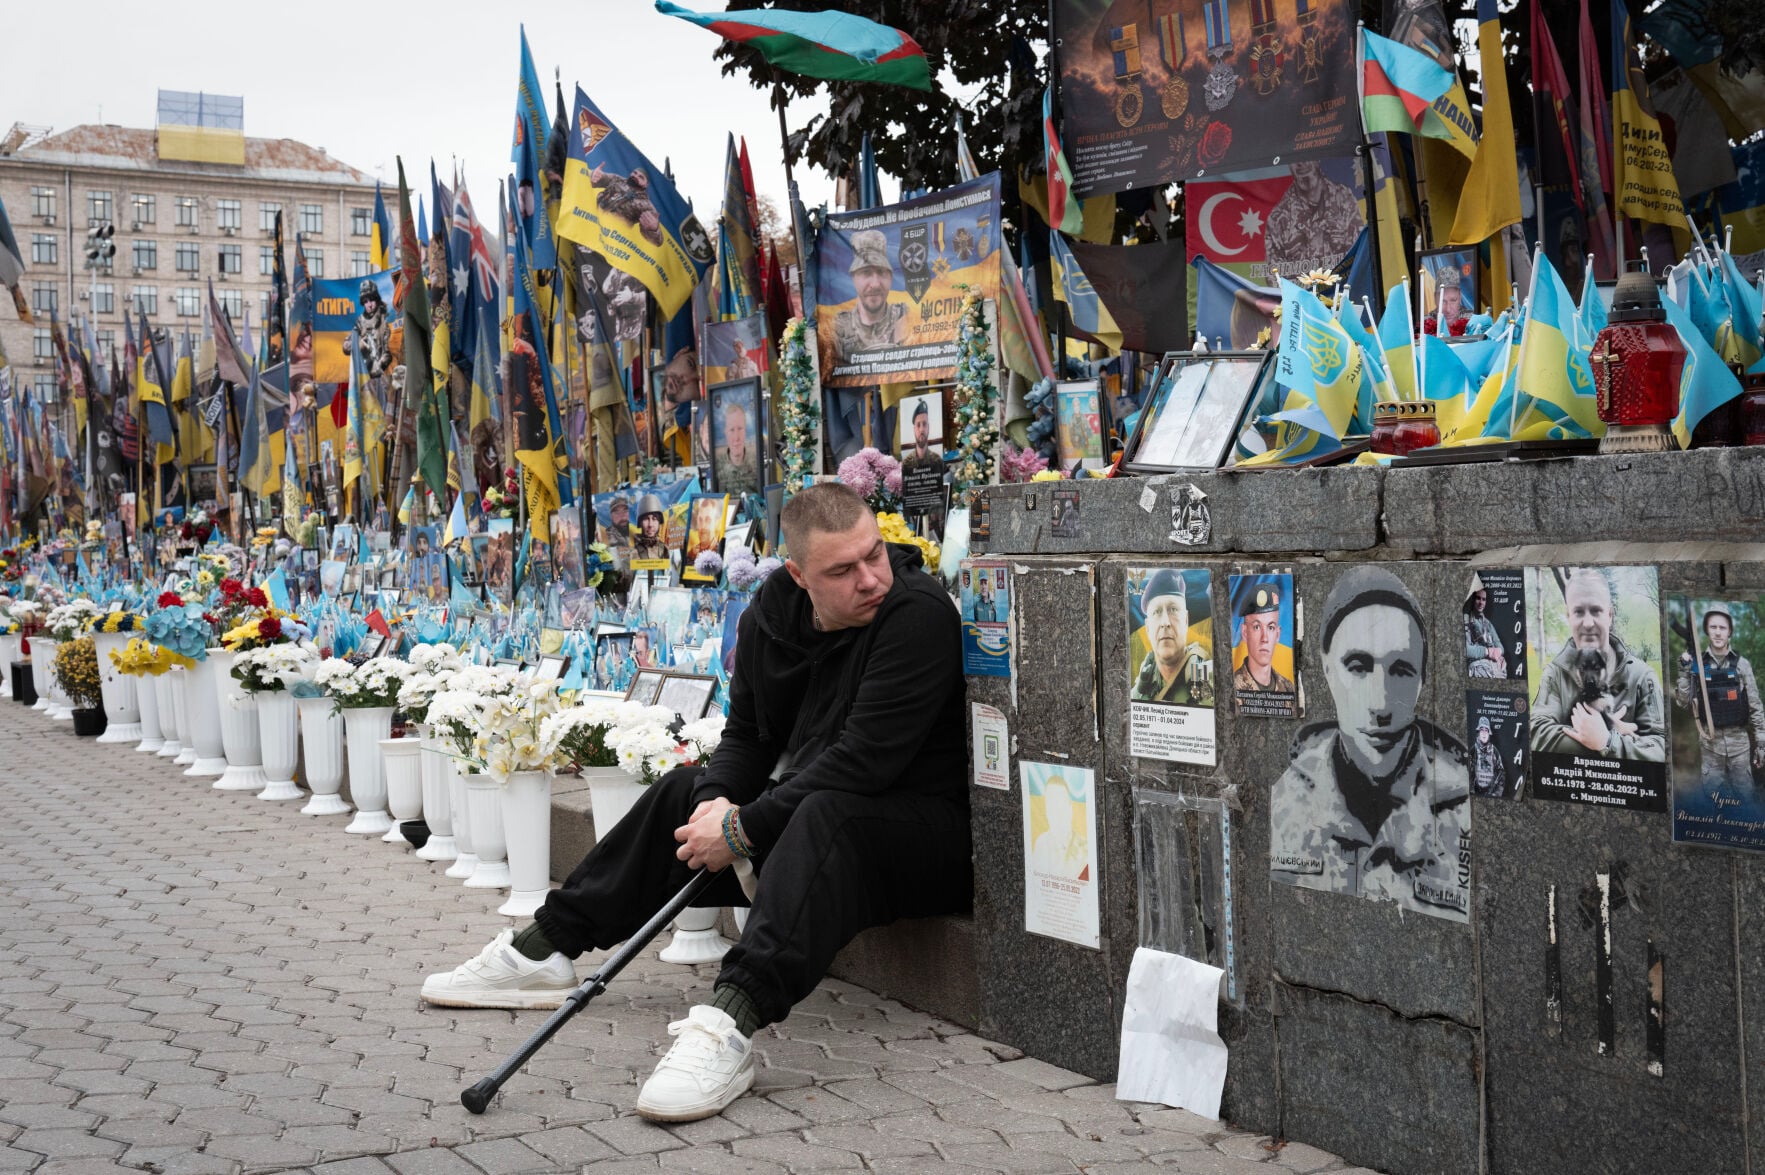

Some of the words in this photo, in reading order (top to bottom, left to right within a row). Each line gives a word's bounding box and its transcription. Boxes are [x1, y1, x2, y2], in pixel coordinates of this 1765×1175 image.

[1574, 756, 1620, 769] Авраменко
[1553, 766, 1583, 778] Андрій
[1585, 769, 1643, 783] Миколайович
[1541, 777, 1586, 789] 05.12.1978
[1570, 792, 1579, 800] с.
[1580, 792, 1626, 805] Миропілля
[1458, 828, 1471, 889] KUSEK
